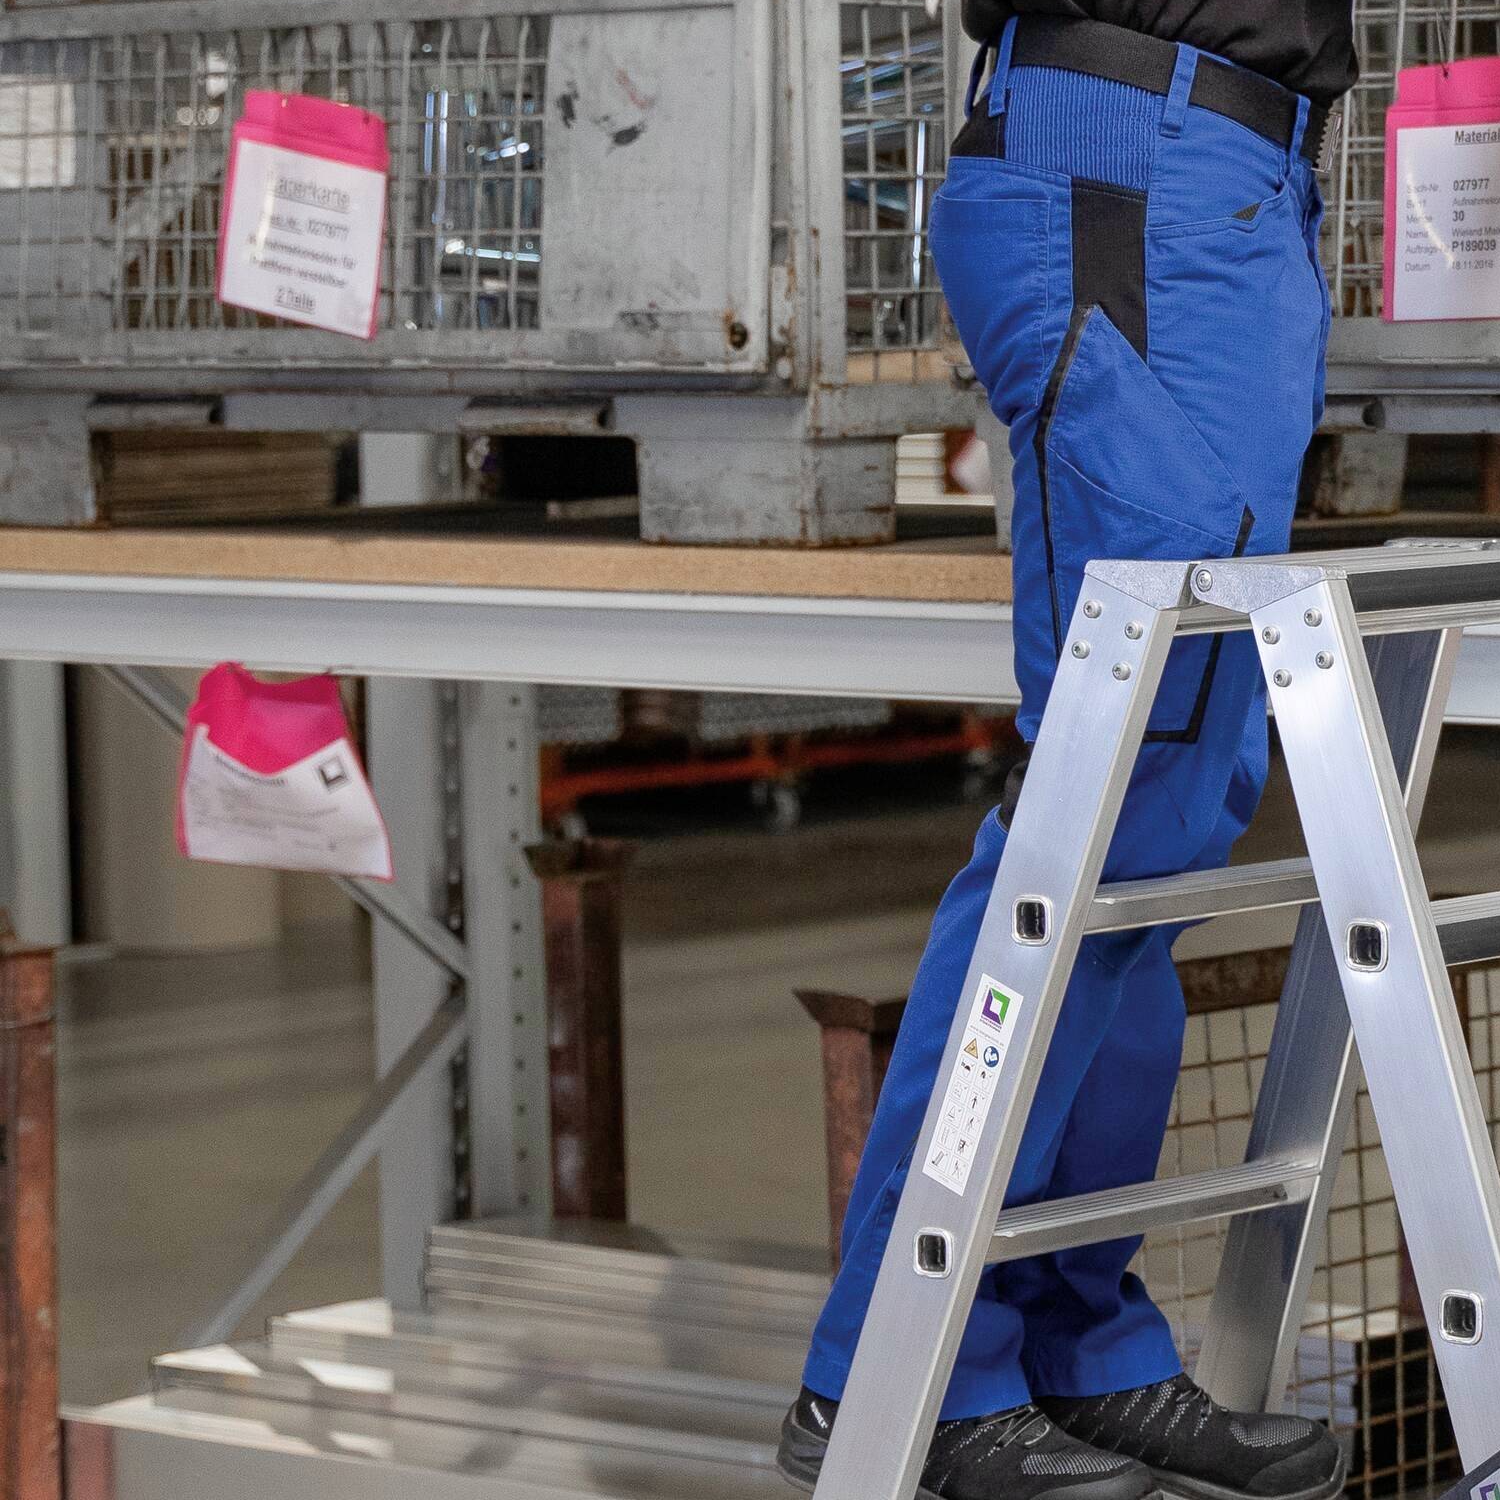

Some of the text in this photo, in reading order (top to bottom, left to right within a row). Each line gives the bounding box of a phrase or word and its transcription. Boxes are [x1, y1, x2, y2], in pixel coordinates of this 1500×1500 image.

[1453, 178, 1490, 192] 027977
[1452, 210, 1465, 222] 30
[1452, 239, 1497, 252] P189039
